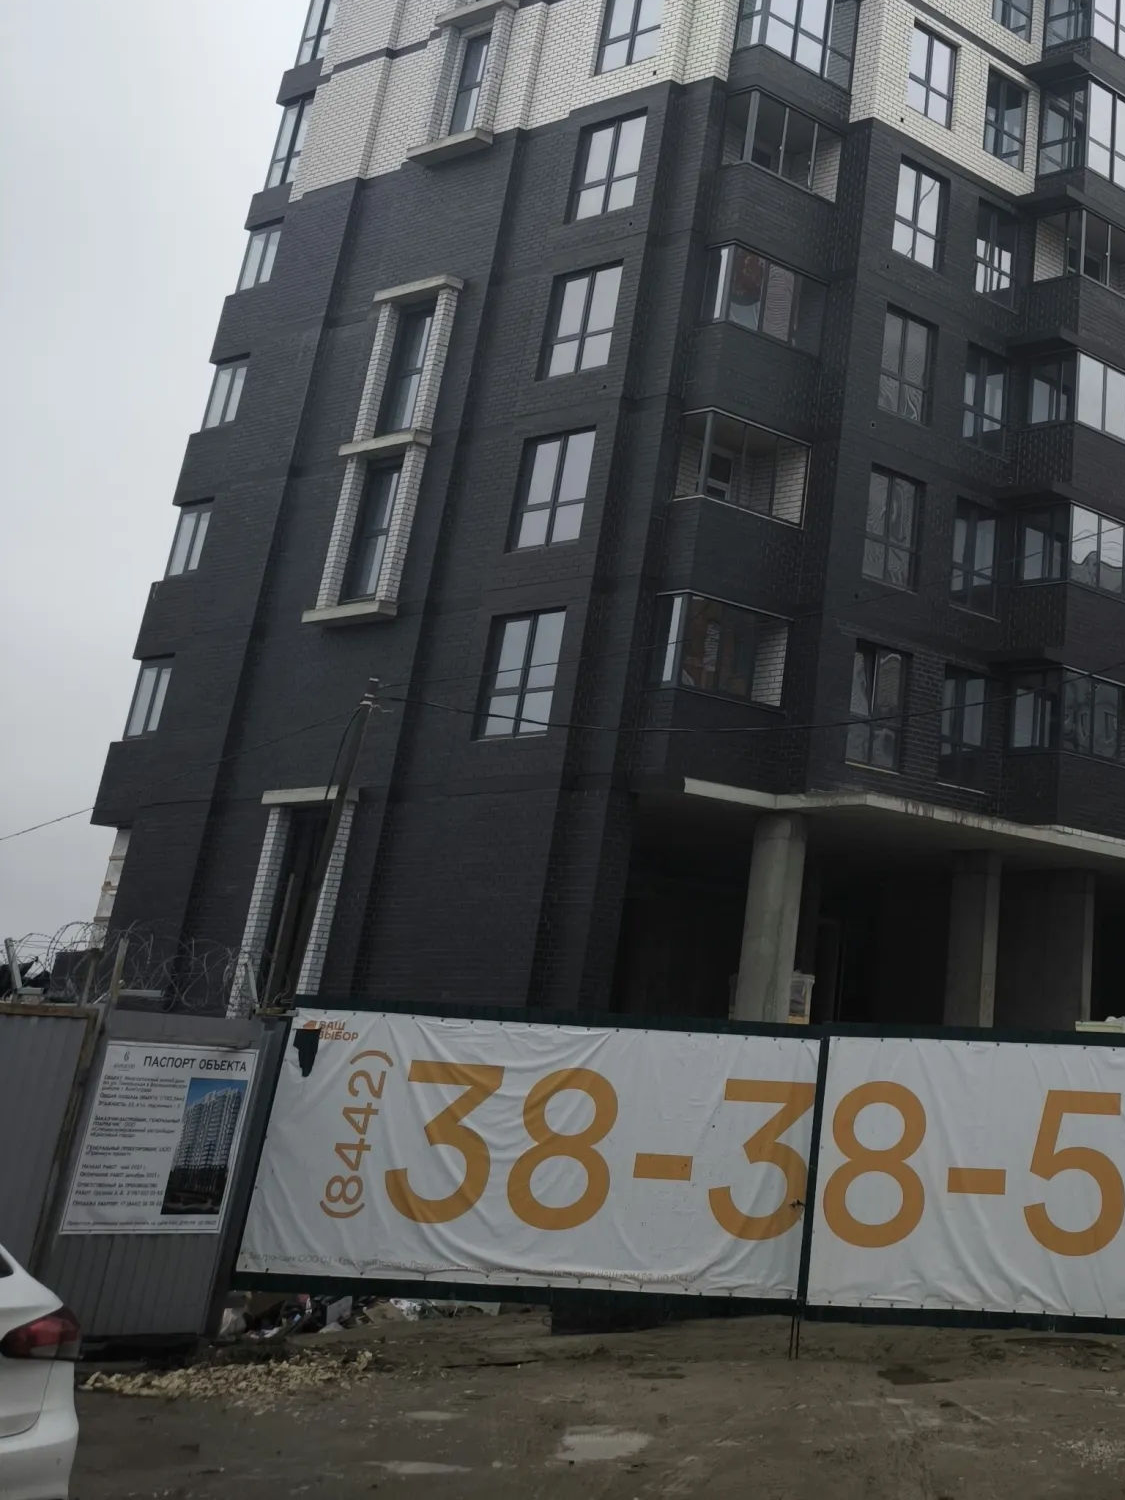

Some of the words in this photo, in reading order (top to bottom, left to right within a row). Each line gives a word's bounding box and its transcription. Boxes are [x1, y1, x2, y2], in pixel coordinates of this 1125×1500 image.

[319, 1021, 346, 1031] ВАШ
[143, 1056, 196, 1069] ПАСПОРТ
[198, 1058, 247, 1072] ОБЪЕКТА
[319, 1050, 394, 1218] (8442)
